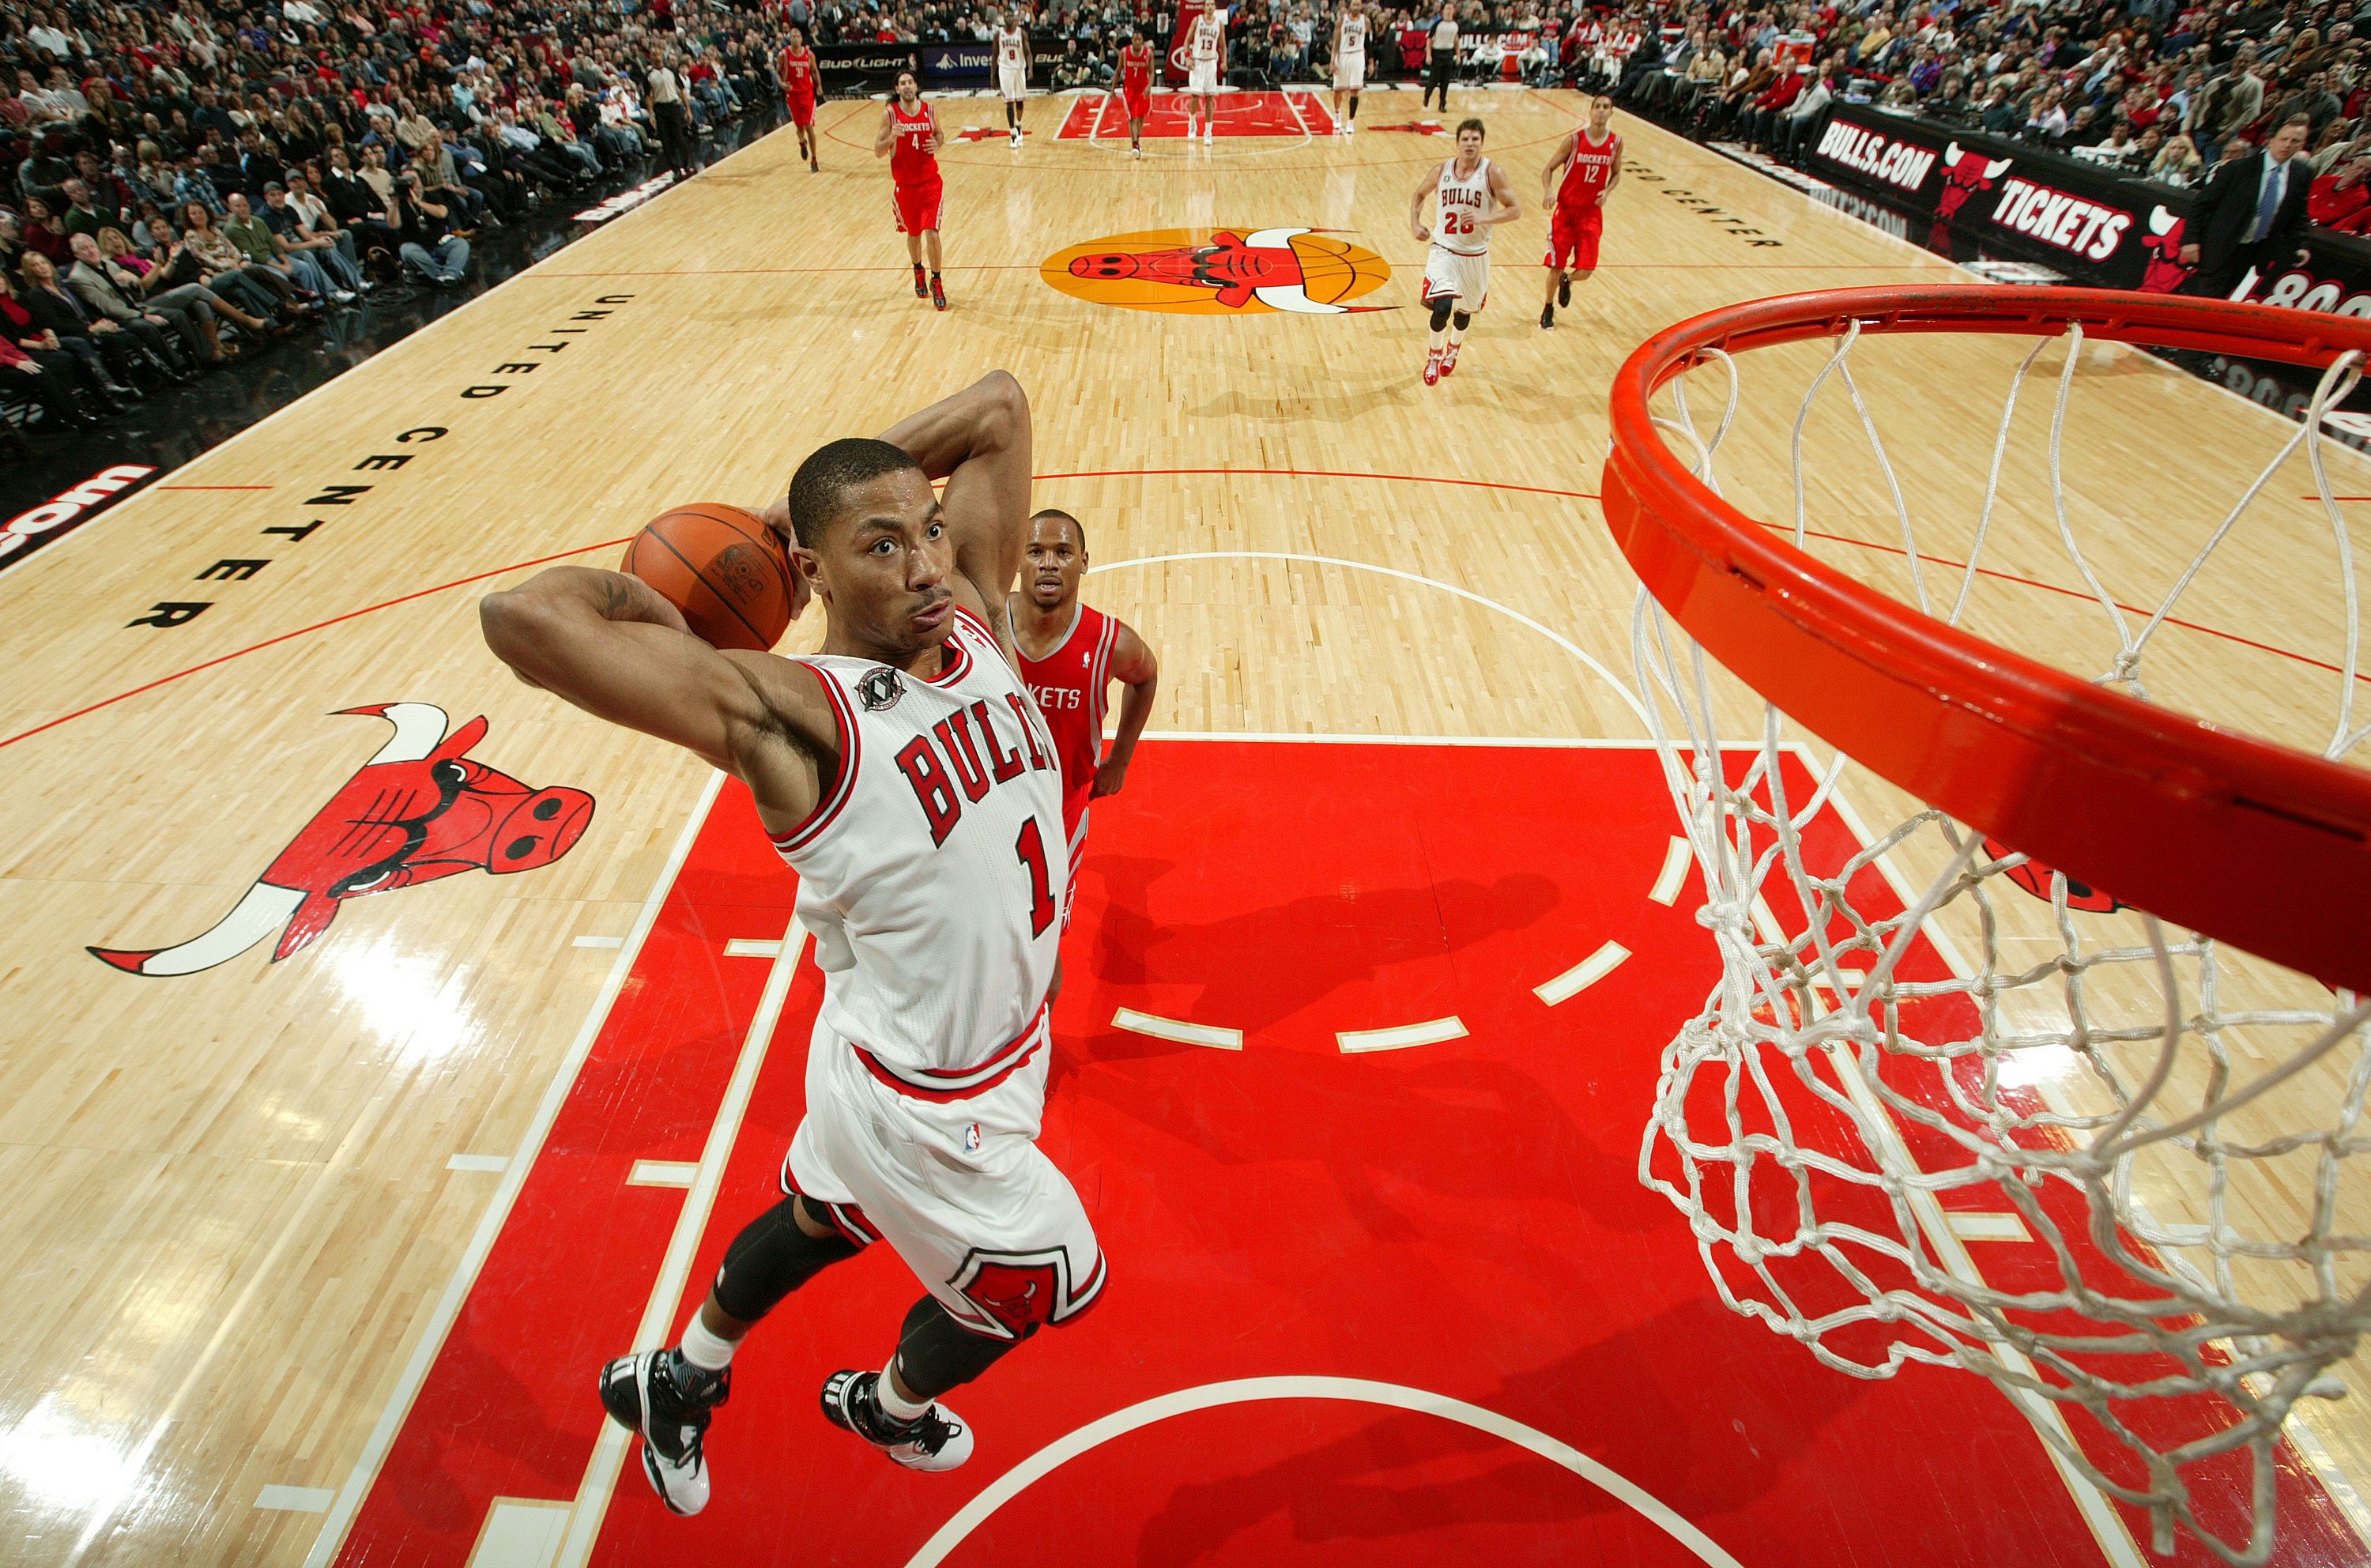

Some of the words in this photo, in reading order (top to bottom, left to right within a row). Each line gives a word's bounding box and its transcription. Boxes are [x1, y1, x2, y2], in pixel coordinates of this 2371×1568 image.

[1009, 50, 1015, 60] 9
[1201, 40, 1213, 51] 13
[819, 59, 852, 70] BUD
[860, 58, 906, 68] LIGHT
[1133, 67, 1138, 77] 7
[902, 122, 930, 132] OCKETS
[912, 133, 919, 150] 4
[1817, 121, 1935, 190] BULLS.COM
[1584, 164, 1600, 183] 12
[1442, 188, 1482, 209] BULLS
[1662, 188, 1783, 247] CENTER
[1992, 179, 2132, 260] TICKETS
[460, 293, 635, 400] UNITED
[123, 426, 449, 630] CENTER
[1027, 682, 1081, 710] KETS
[895, 692, 1057, 849] BULL
[1015, 814, 1056, 940] 1
